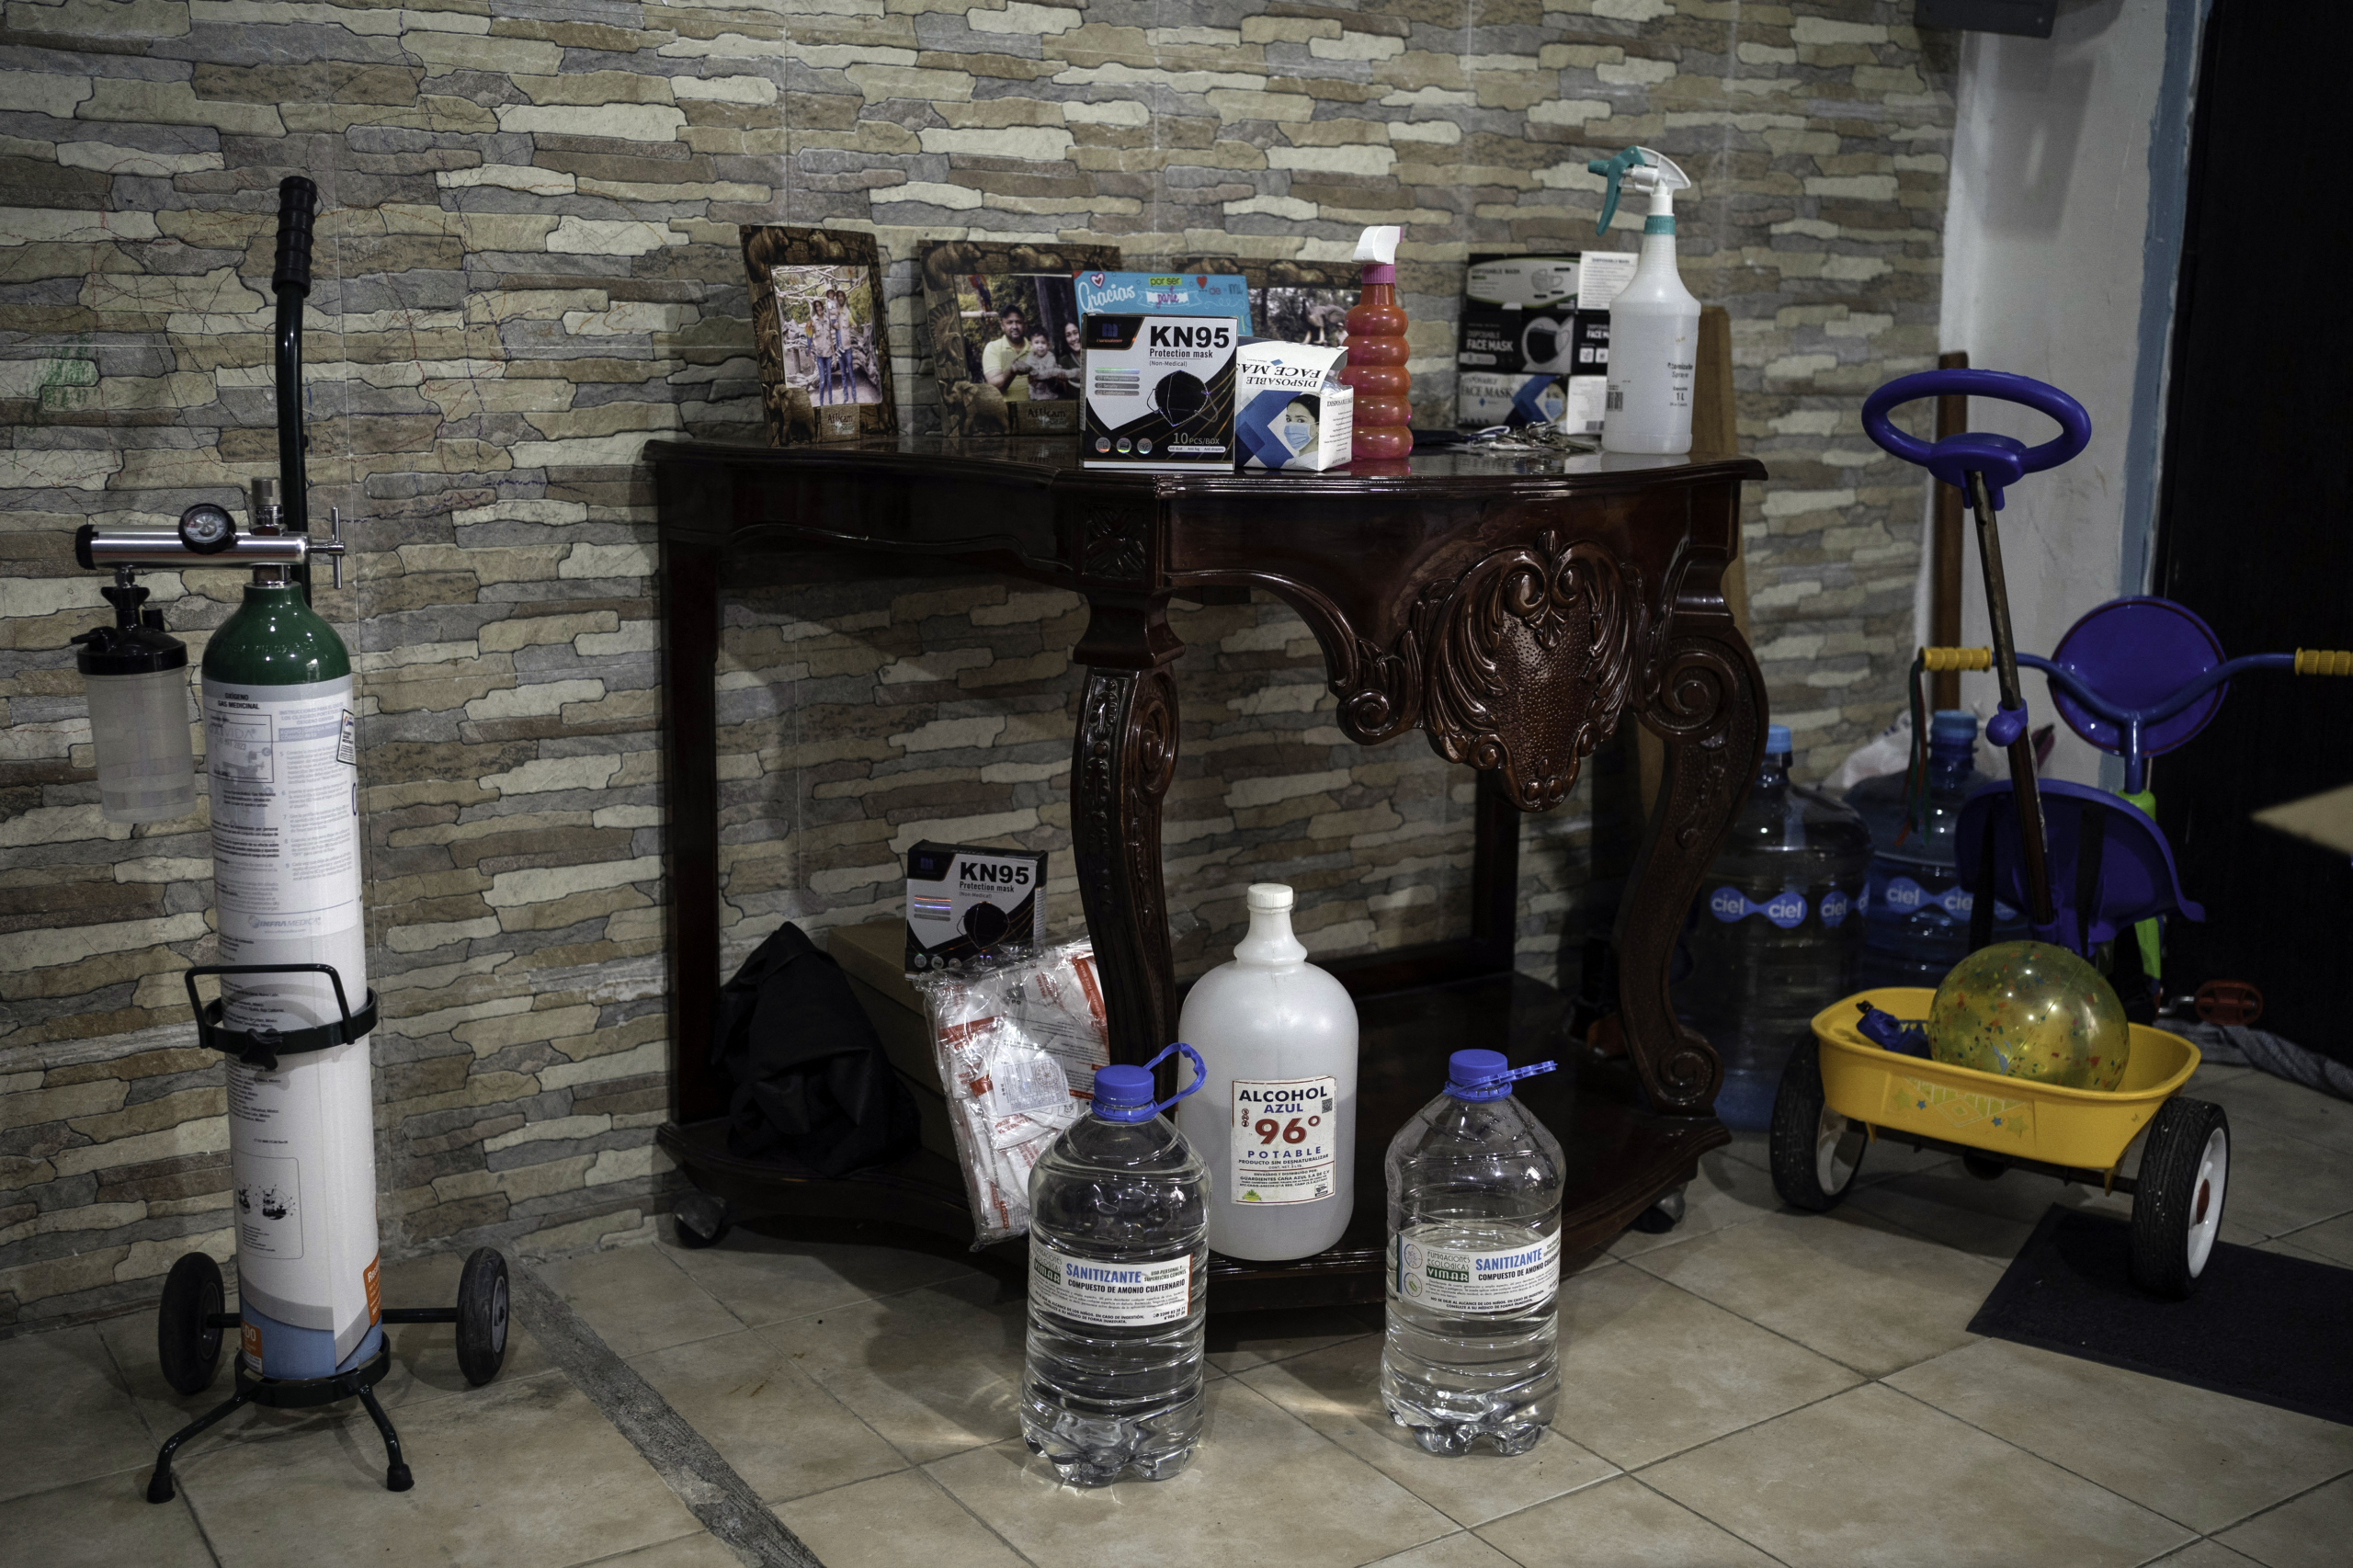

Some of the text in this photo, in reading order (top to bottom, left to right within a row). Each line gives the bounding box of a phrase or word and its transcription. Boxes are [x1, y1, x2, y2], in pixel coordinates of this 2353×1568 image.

[1150, 278, 1180, 287] por ser
[1078, 281, 1135, 311] Gracias
[1156, 286, 1179, 309] parte
[1209, 286, 1222, 295] de
[1150, 325, 1230, 349] KN95
[1466, 338, 1514, 352] FACE MASK
[1150, 348, 1213, 358] Protection mask
[1236, 362, 1324, 379] FACE MA
[1246, 376, 1318, 388] DISPOSABLE
[1485, 386, 1512, 398] MASK
[1173, 432, 1221, 446] 10 PCS/BOX
[218, 699, 260, 710] GAS MEDICINAL
[960, 861, 1029, 885] KN95
[959, 881, 1015, 893] Protection mask
[1886, 884, 1920, 906] ciel
[1944, 890, 1973, 911] cie
[1711, 893, 1802, 919] ciel ciel
[1821, 898, 1847, 918] ciel
[1238, 1085, 1327, 1103] ALCOHOL
[1264, 1103, 1303, 1114] AZUL
[1255, 1115, 1322, 1145] 96°
[1247, 1146, 1321, 1159] POTABLE
[1282, 1153, 1329, 1165] DESNATURALIZAR
[1427, 1251, 1471, 1264] FUMIGACIONES
[1427, 1258, 1470, 1271] ECOLOGICAS
[1475, 1248, 1542, 1271] SANITIZANTE
[1066, 1263, 1142, 1284] SANITIZANTE
[1144, 1269, 1187, 1282] SUPERFICIES COMUNES
[1427, 1267, 1469, 1282] VIMAR
[1478, 1262, 1544, 1281] COMPUESTO DE AMONIO
[1068, 1279, 1106, 1293] COMPUESTO
[1145, 1278, 1186, 1293] CUATERNARIO
[1051, 1300, 1066, 1311] ALCANCE
